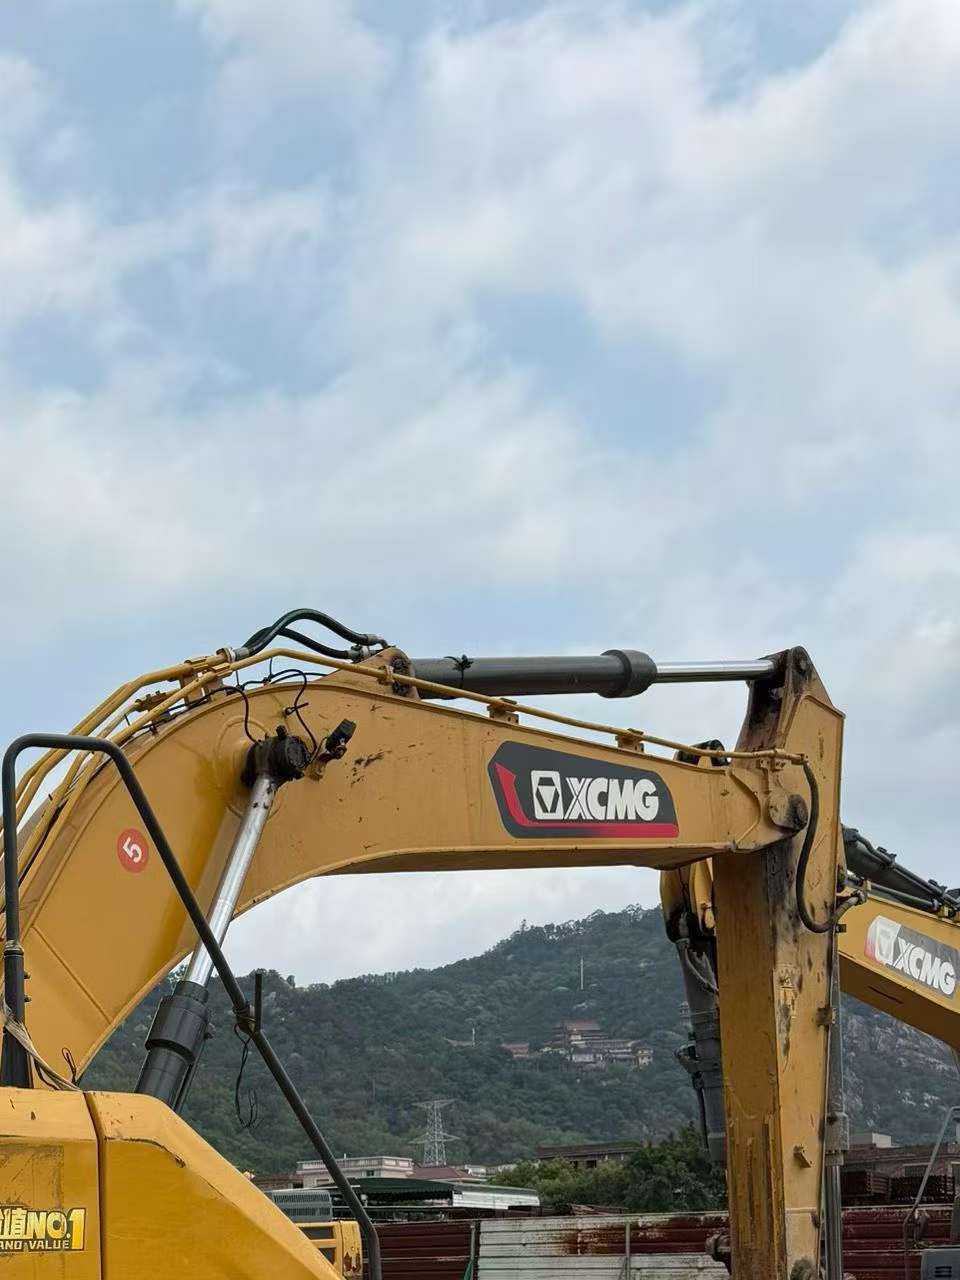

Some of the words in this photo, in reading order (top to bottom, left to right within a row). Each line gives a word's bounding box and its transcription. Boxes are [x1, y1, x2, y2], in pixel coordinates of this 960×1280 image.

[563, 777, 659, 821] XCMG
[123, 836, 142, 863] 5
[893, 936, 955, 995] XCMG
[28, 1239, 70, 1250] VALUE
